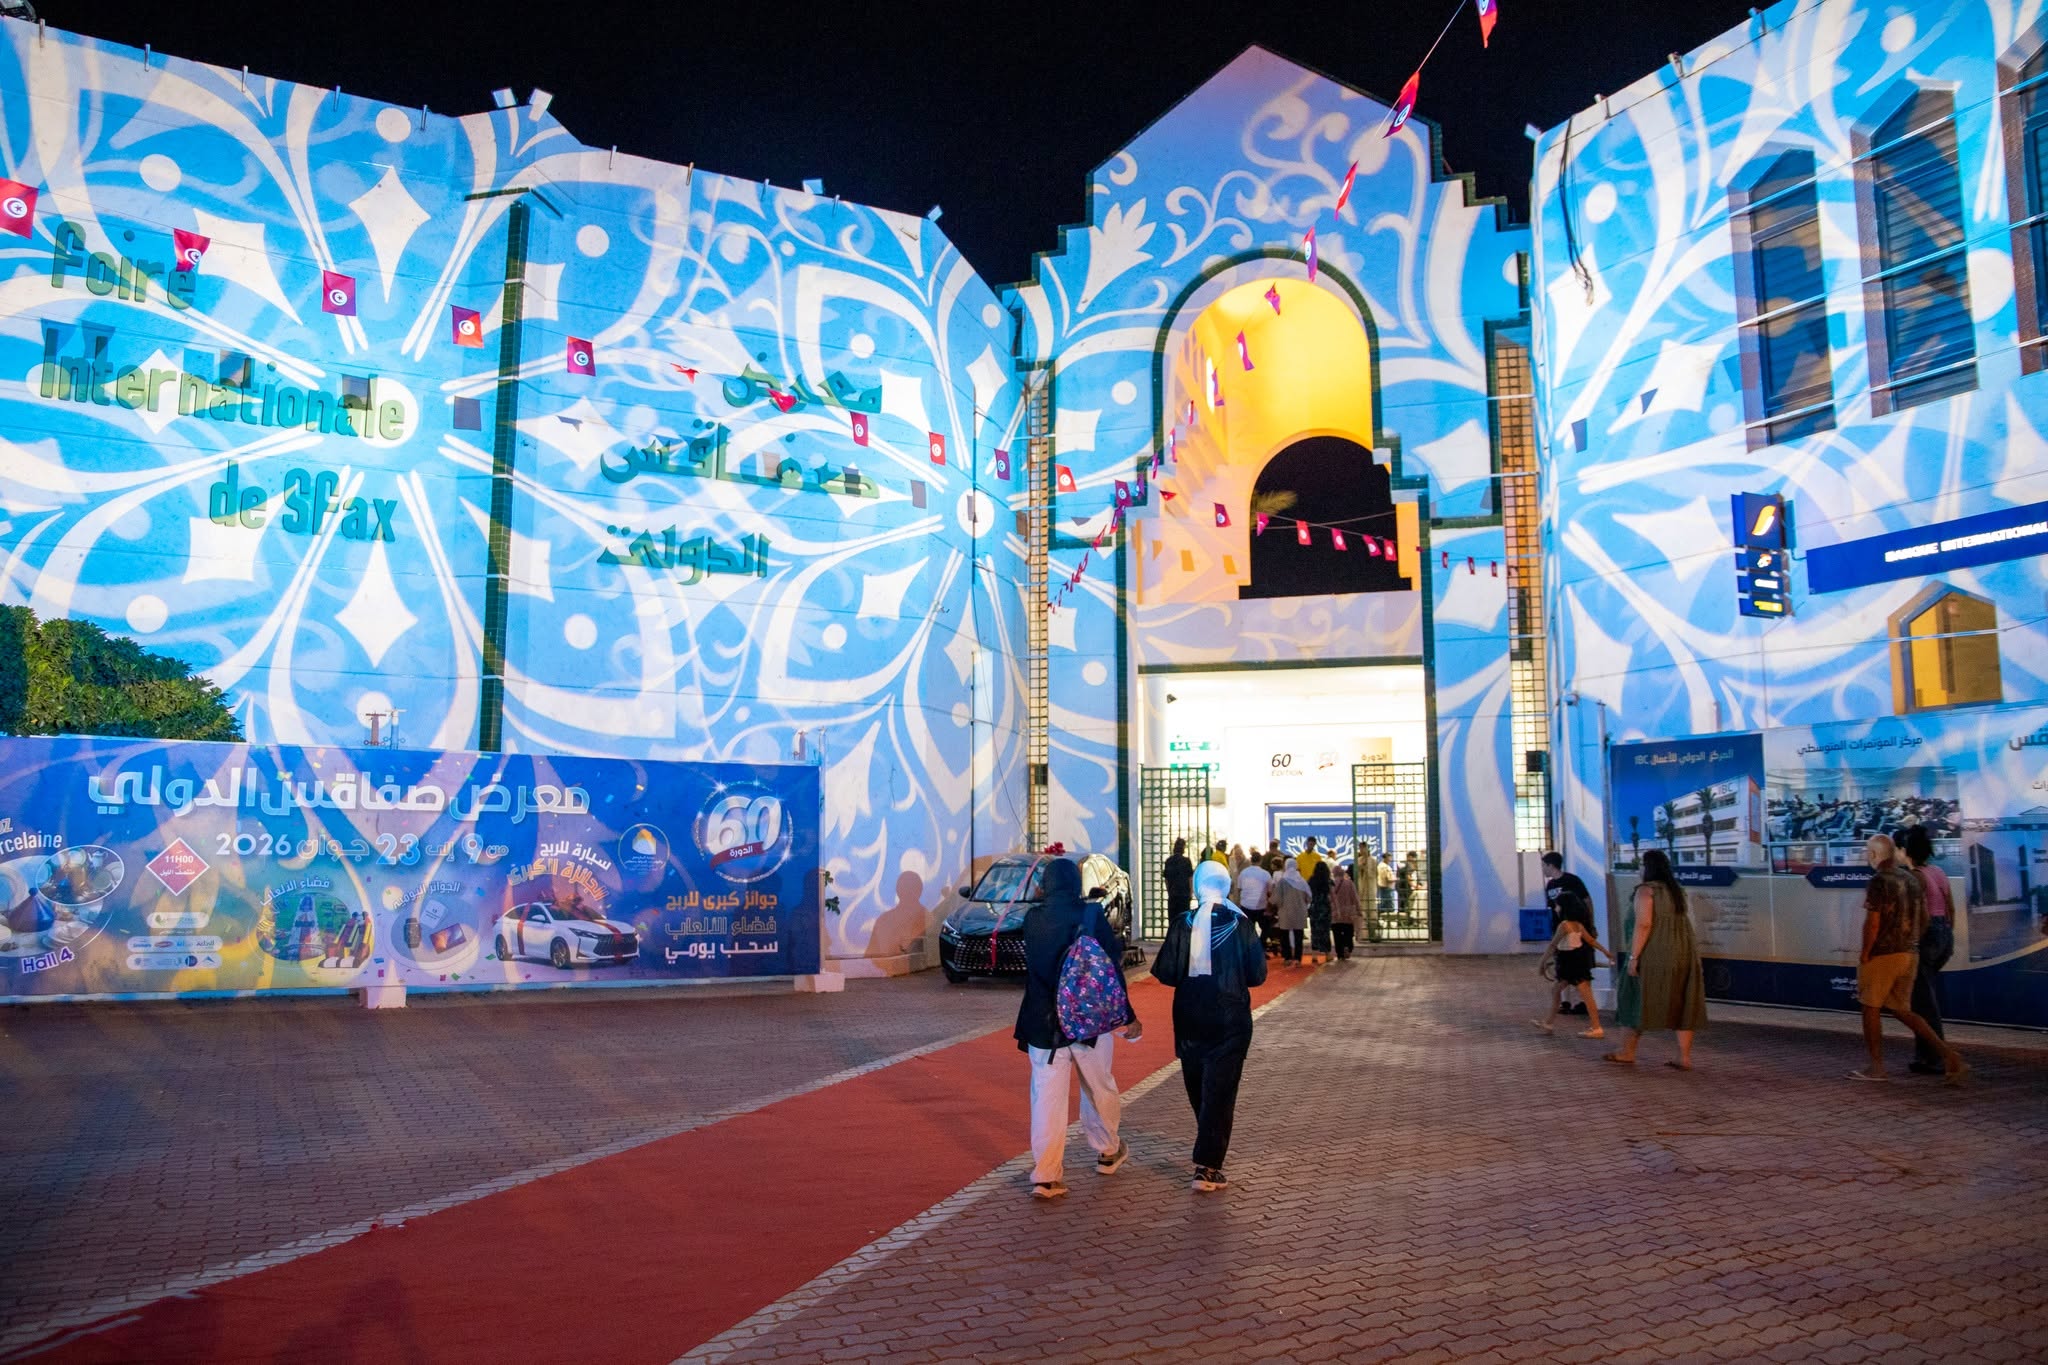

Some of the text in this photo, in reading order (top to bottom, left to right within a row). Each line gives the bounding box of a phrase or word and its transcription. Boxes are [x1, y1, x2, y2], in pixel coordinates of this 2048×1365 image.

[51, 220, 198, 311] Foire
[39, 326, 406, 441] Internationale
[600, 419, 880, 499] صفاقس
[209, 459, 399, 543] de Sfax
[1899, 736, 1923, 748] مركز
[1271, 753, 1292, 768] 60
[87, 766, 590, 825] معرض صفاقس الدولي
[706, 796, 782, 856] 60
[165, 855, 194, 864] 11H00
[215, 833, 509, 866] من 9 إلى 23 جوان 2026
[540, 841, 570, 857] للربح
[572, 843, 612, 871] سيارة
[729, 845, 753, 858] الدورة
[300, 876, 330, 889] فضاء
[507, 858, 559, 886] الكبرى
[560, 860, 610, 901] الجائزة
[429, 882, 461, 894] الجوائز
[666, 891, 778, 911] جوائز كبرى للربح
[731, 916, 777, 937] فضاء
[21, 946, 75, 974] Hall 4
[665, 941, 778, 964] سحب يومي
